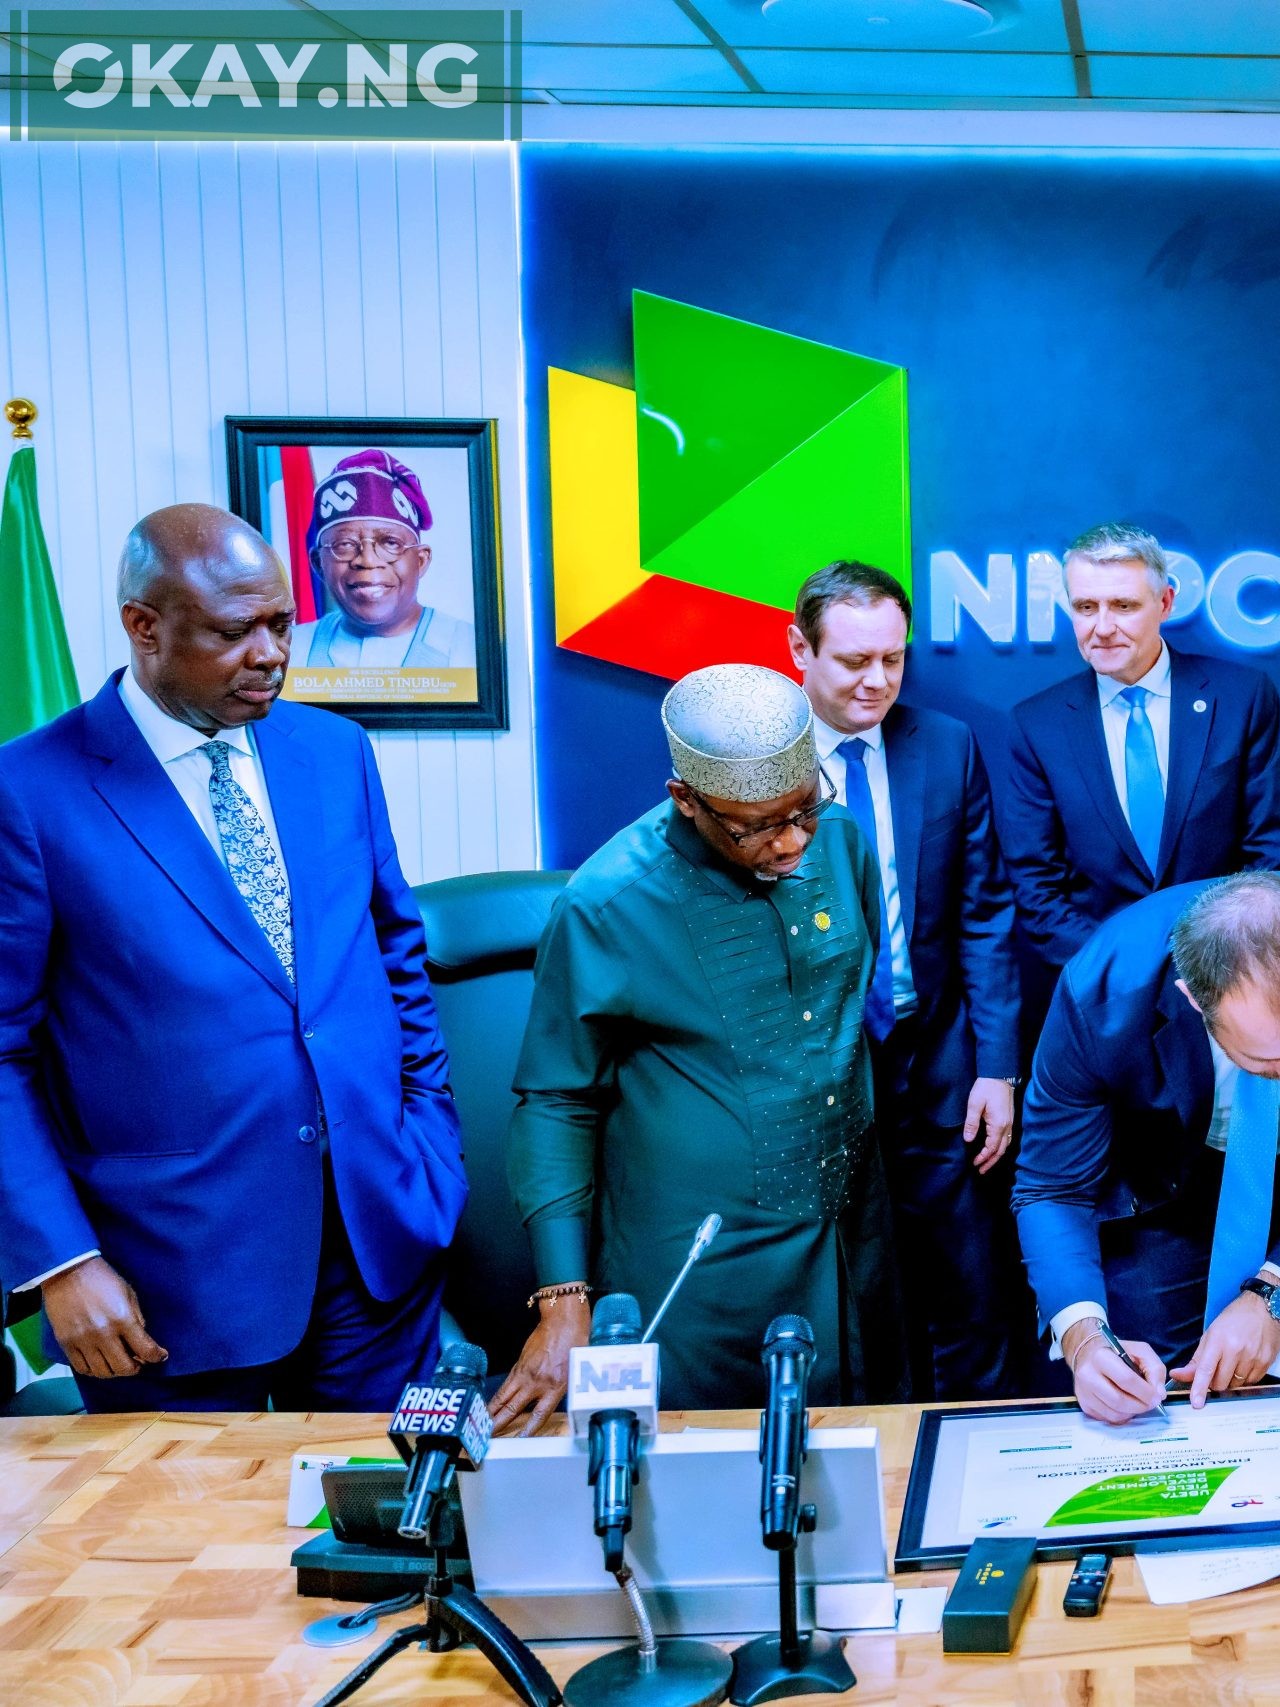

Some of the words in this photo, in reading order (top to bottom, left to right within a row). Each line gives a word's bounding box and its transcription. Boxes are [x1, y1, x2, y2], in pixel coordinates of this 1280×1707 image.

[294, 677, 331, 688] BOLA
[334, 677, 385, 688] AHMED
[388, 677, 441, 688] TINUBU
[401, 1387, 466, 1412] ARISE
[392, 1413, 457, 1433] NEWS
[1112, 1461, 1205, 1473] INVESTMENT
[1037, 1469, 1108, 1479] DECISION
[1139, 1472, 1206, 1482] PROJECT
[1096, 1477, 1208, 1491] DEVELOPMENT
[1167, 1483, 1209, 1491] FIELD
[1160, 1490, 1209, 1499] UBETA
